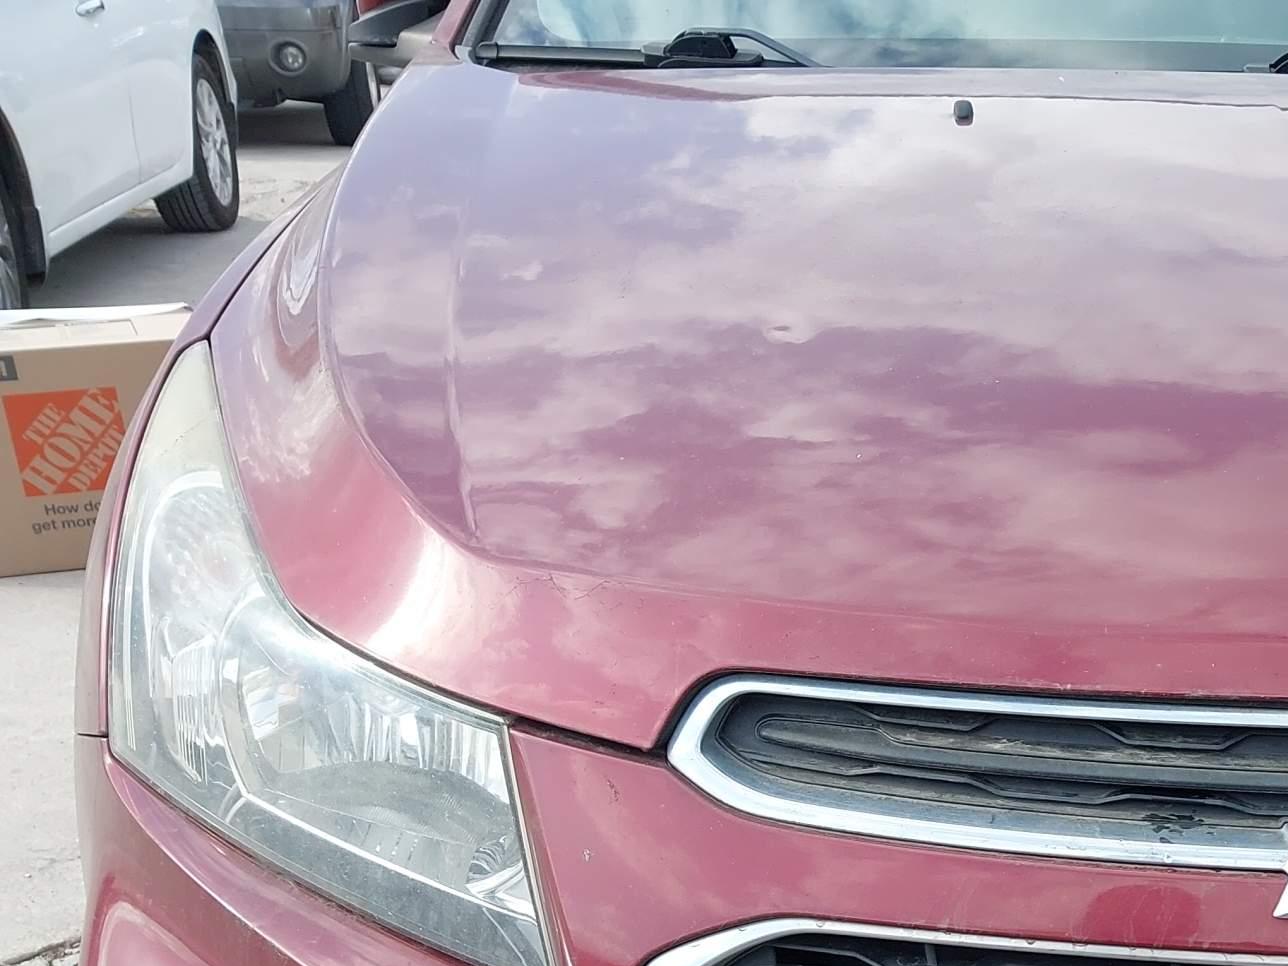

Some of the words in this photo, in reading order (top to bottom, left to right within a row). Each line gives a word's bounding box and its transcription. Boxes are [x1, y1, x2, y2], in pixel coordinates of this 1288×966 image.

[20, 388, 118, 494] HOME
[22, 402, 66, 445] THE
[67, 424, 124, 491] DEPOT
[32, 519, 57, 534] get
[44, 503, 79, 516] How
